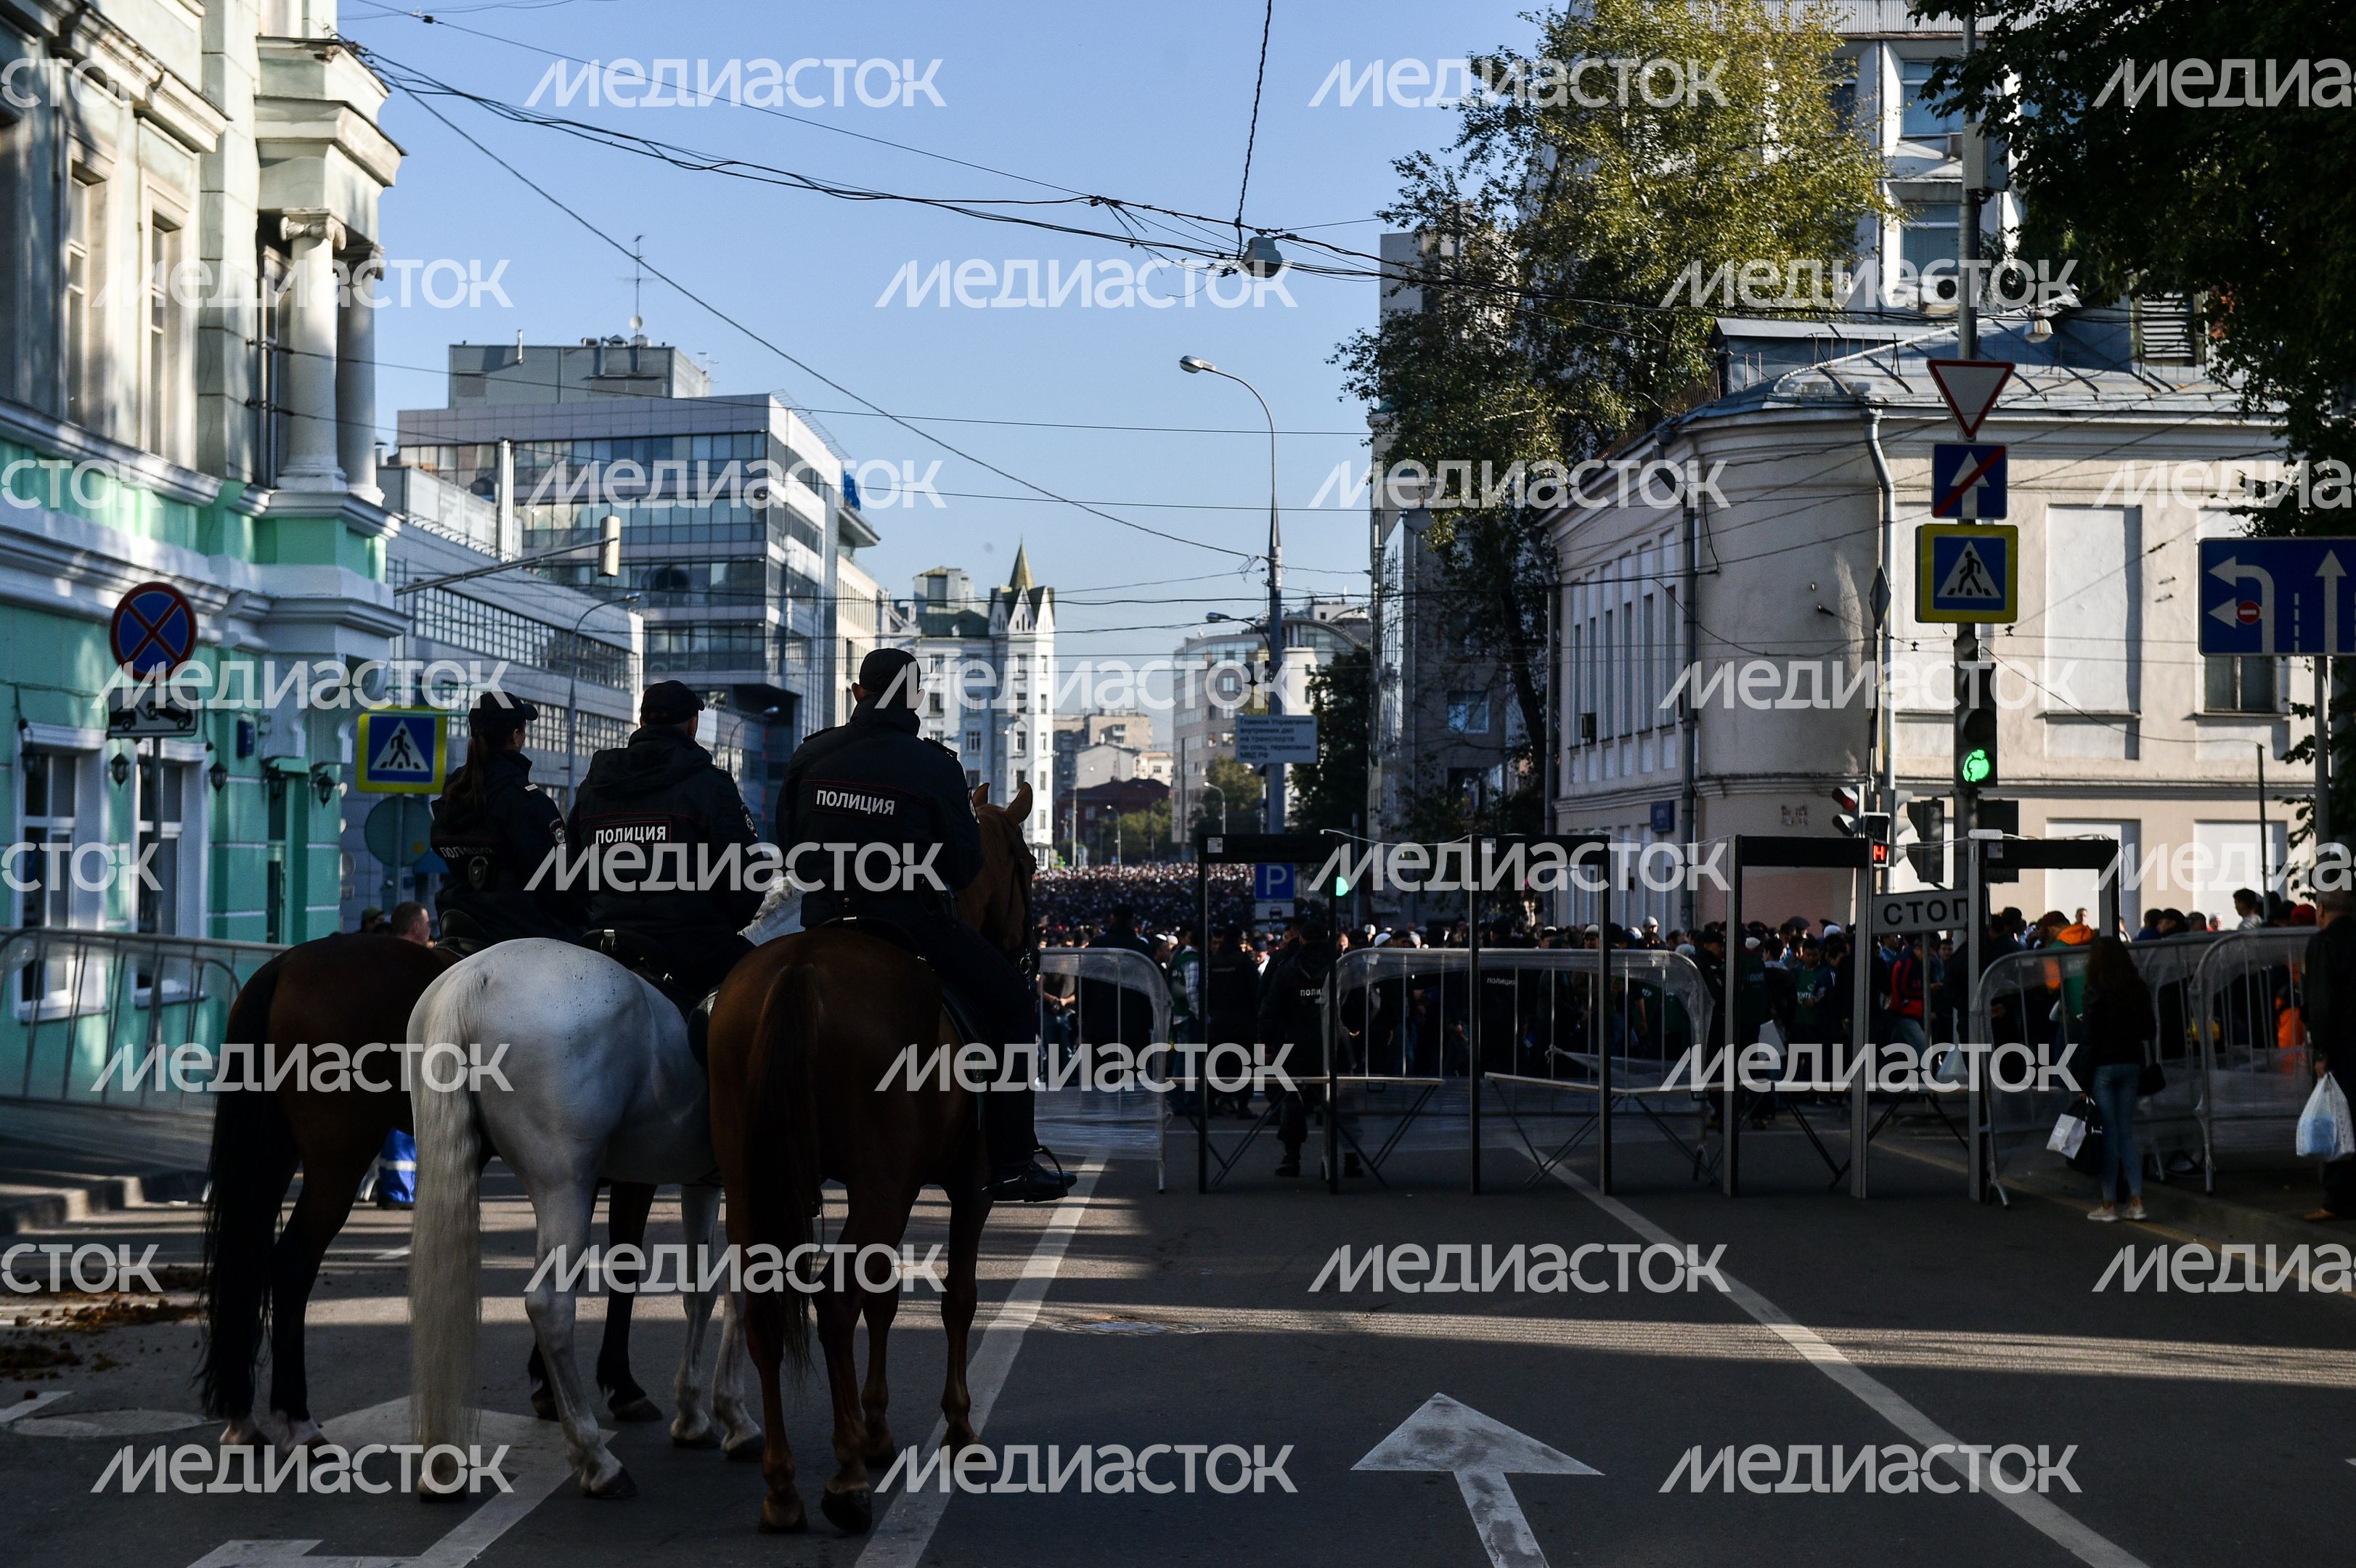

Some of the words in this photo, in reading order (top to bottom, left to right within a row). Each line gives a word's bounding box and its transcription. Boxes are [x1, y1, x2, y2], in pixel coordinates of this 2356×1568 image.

[816, 790, 895, 815] ПОЛИЦИЯ
[595, 826, 667, 844] ПОЛИЦИЯ
[1266, 865, 1287, 895] P
[1883, 898, 1968, 925] СТОП
[1300, 988, 1321, 997] ПОЛИ
